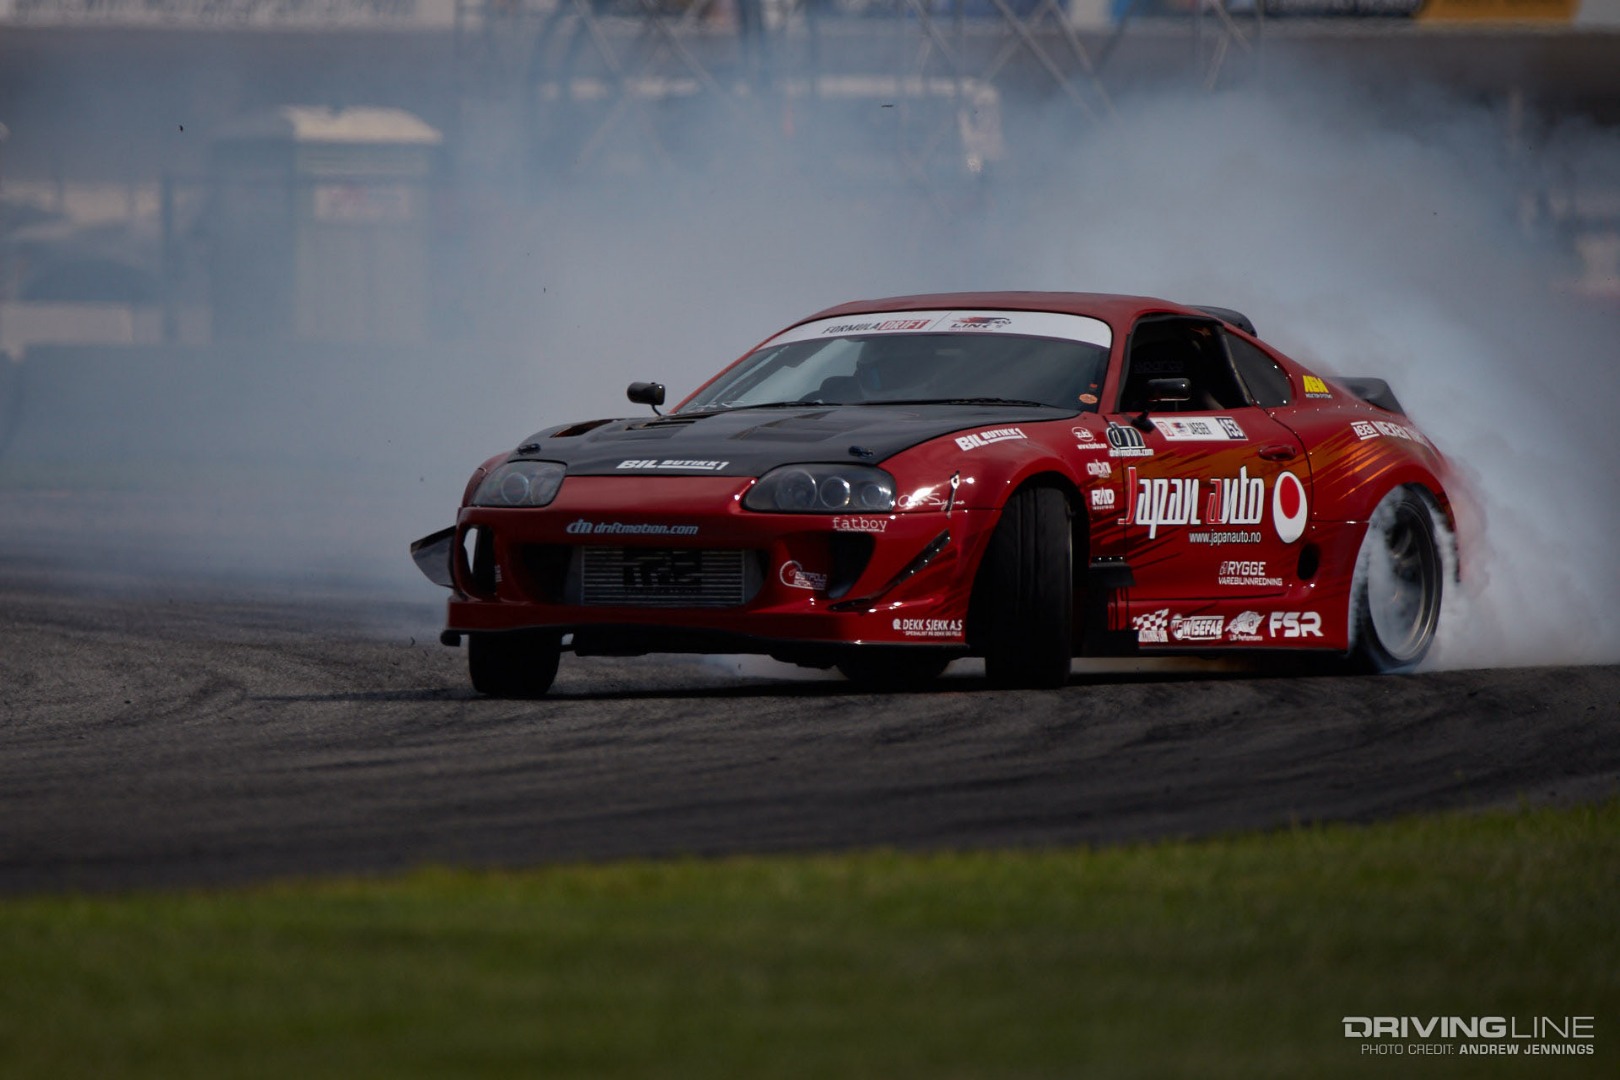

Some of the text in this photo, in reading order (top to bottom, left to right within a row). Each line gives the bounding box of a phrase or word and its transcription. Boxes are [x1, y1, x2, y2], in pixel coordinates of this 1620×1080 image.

[822, 319, 931, 334] FORMULA DRIFT
[1217, 419, 1244, 437] 153
[955, 434, 989, 451] BIL
[616, 460, 658, 469] BIL
[1091, 486, 1115, 506] RAD
[1117, 465, 1265, 540] Japan auto
[594, 522, 699, 535] driftmotion.com
[832, 517, 888, 532] fatboy
[1189, 529, 1261, 546] www.japanauto.no
[1227, 561, 1267, 576] RYGGE
[1218, 576, 1283, 587] VAREBILINNREDNING
[902, 618, 924, 631] DEKK
[925, 618, 949, 631] SJEKK
[1183, 618, 1223, 636] WISEFAB
[1269, 611, 1324, 637] FSR
